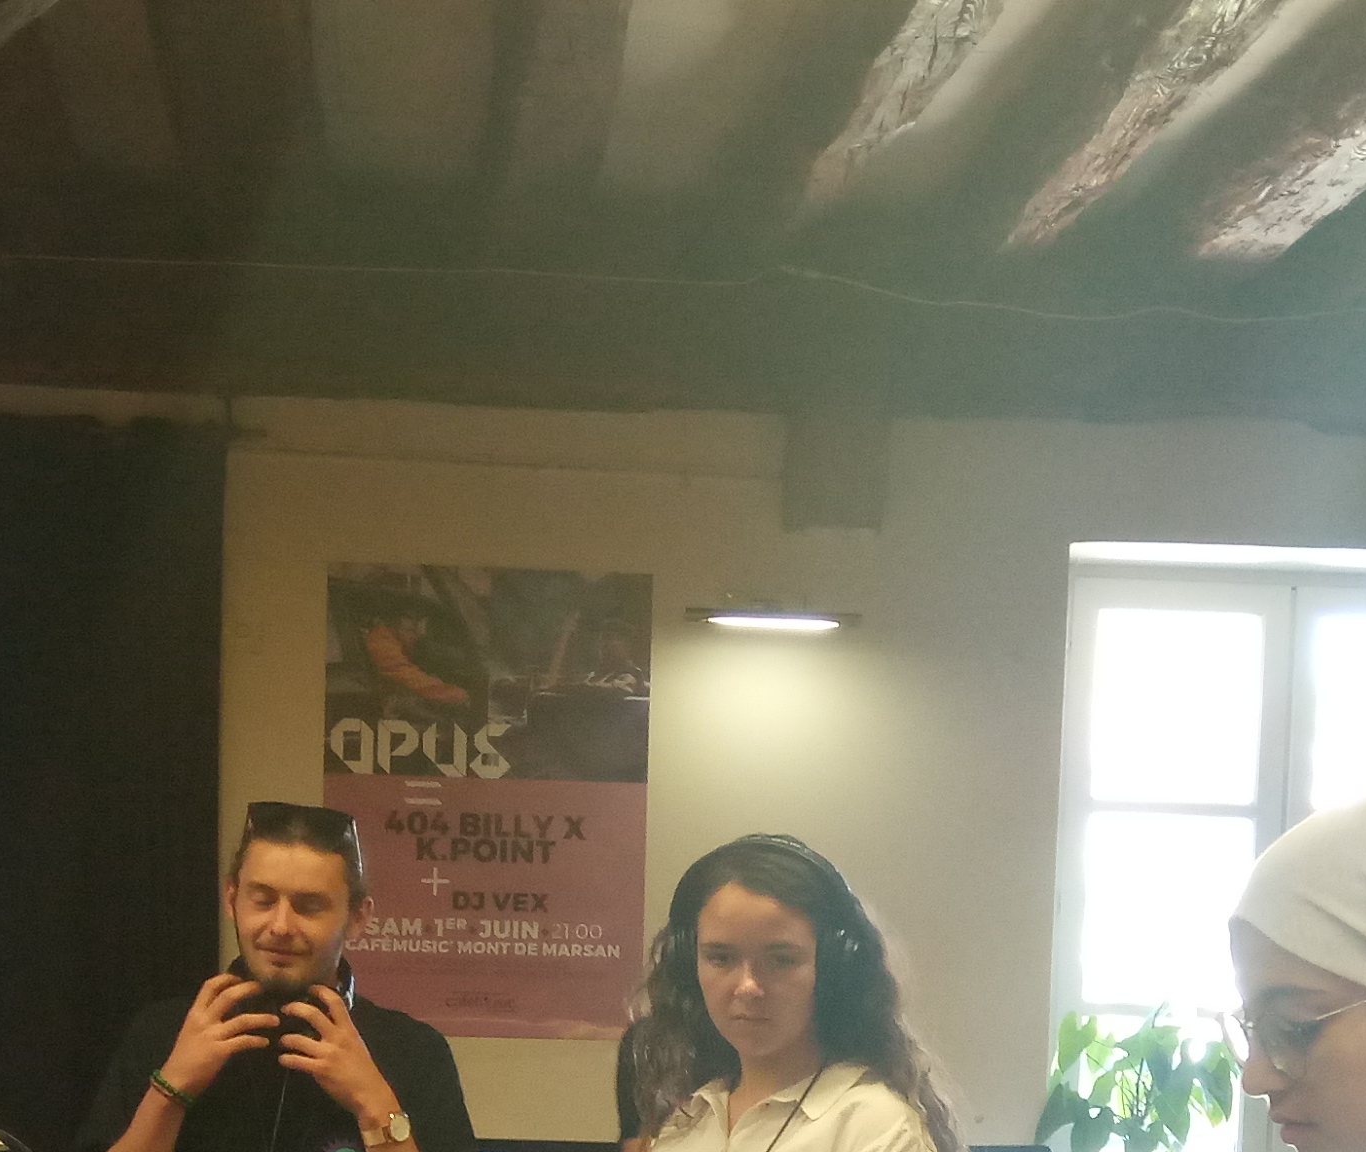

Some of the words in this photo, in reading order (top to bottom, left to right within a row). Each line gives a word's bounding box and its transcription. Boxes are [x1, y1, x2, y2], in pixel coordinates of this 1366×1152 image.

[330, 717, 511, 779] OPUS
[385, 810, 450, 834] 404
[459, 812, 555, 838] BILLY
[563, 815, 586, 840] X
[416, 837, 556, 864] K.POINT
[452, 891, 485, 911] DJ
[493, 892, 548, 913] VEX
[365, 917, 422, 937] SAM
[479, 919, 540, 940] JUIN
[458, 940, 511, 955] MONT
[515, 942, 538, 956] DE
[542, 942, 621, 959] MARSAN
